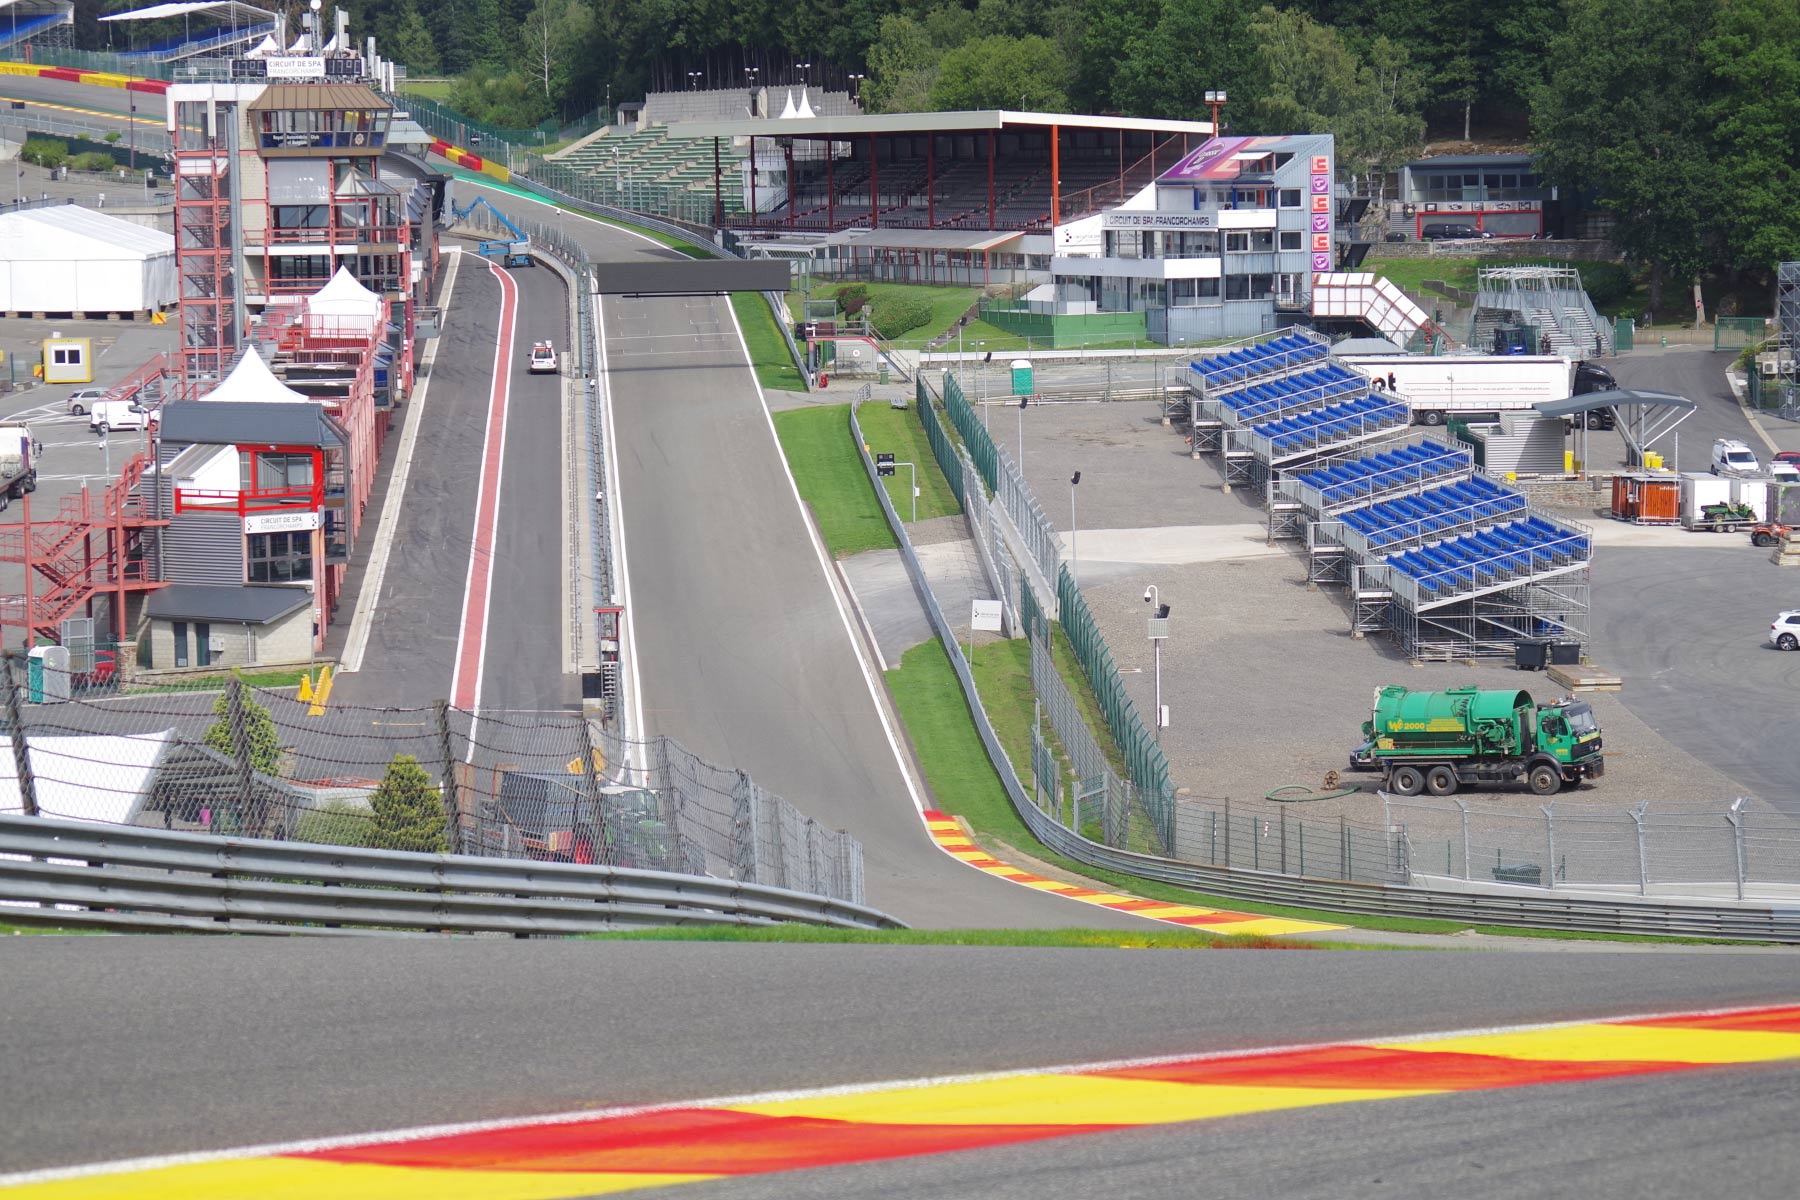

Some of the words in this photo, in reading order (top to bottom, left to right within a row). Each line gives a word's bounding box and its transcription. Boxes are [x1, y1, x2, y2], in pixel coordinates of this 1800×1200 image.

[268, 60, 295, 68] CIRCUIT
[297, 60, 306, 68] DE
[308, 60, 322, 68] SPA
[1109, 215, 1131, 225] CIRCUIT
[1133, 216, 1141, 225] DE
[1142, 216, 1153, 225] SPA
[1155, 216, 1210, 226] FRANCORCHAMPS
[260, 517, 282, 525] CIRCUIT
[291, 515, 302, 523] SPA
[1404, 721, 1425, 730] 2000
